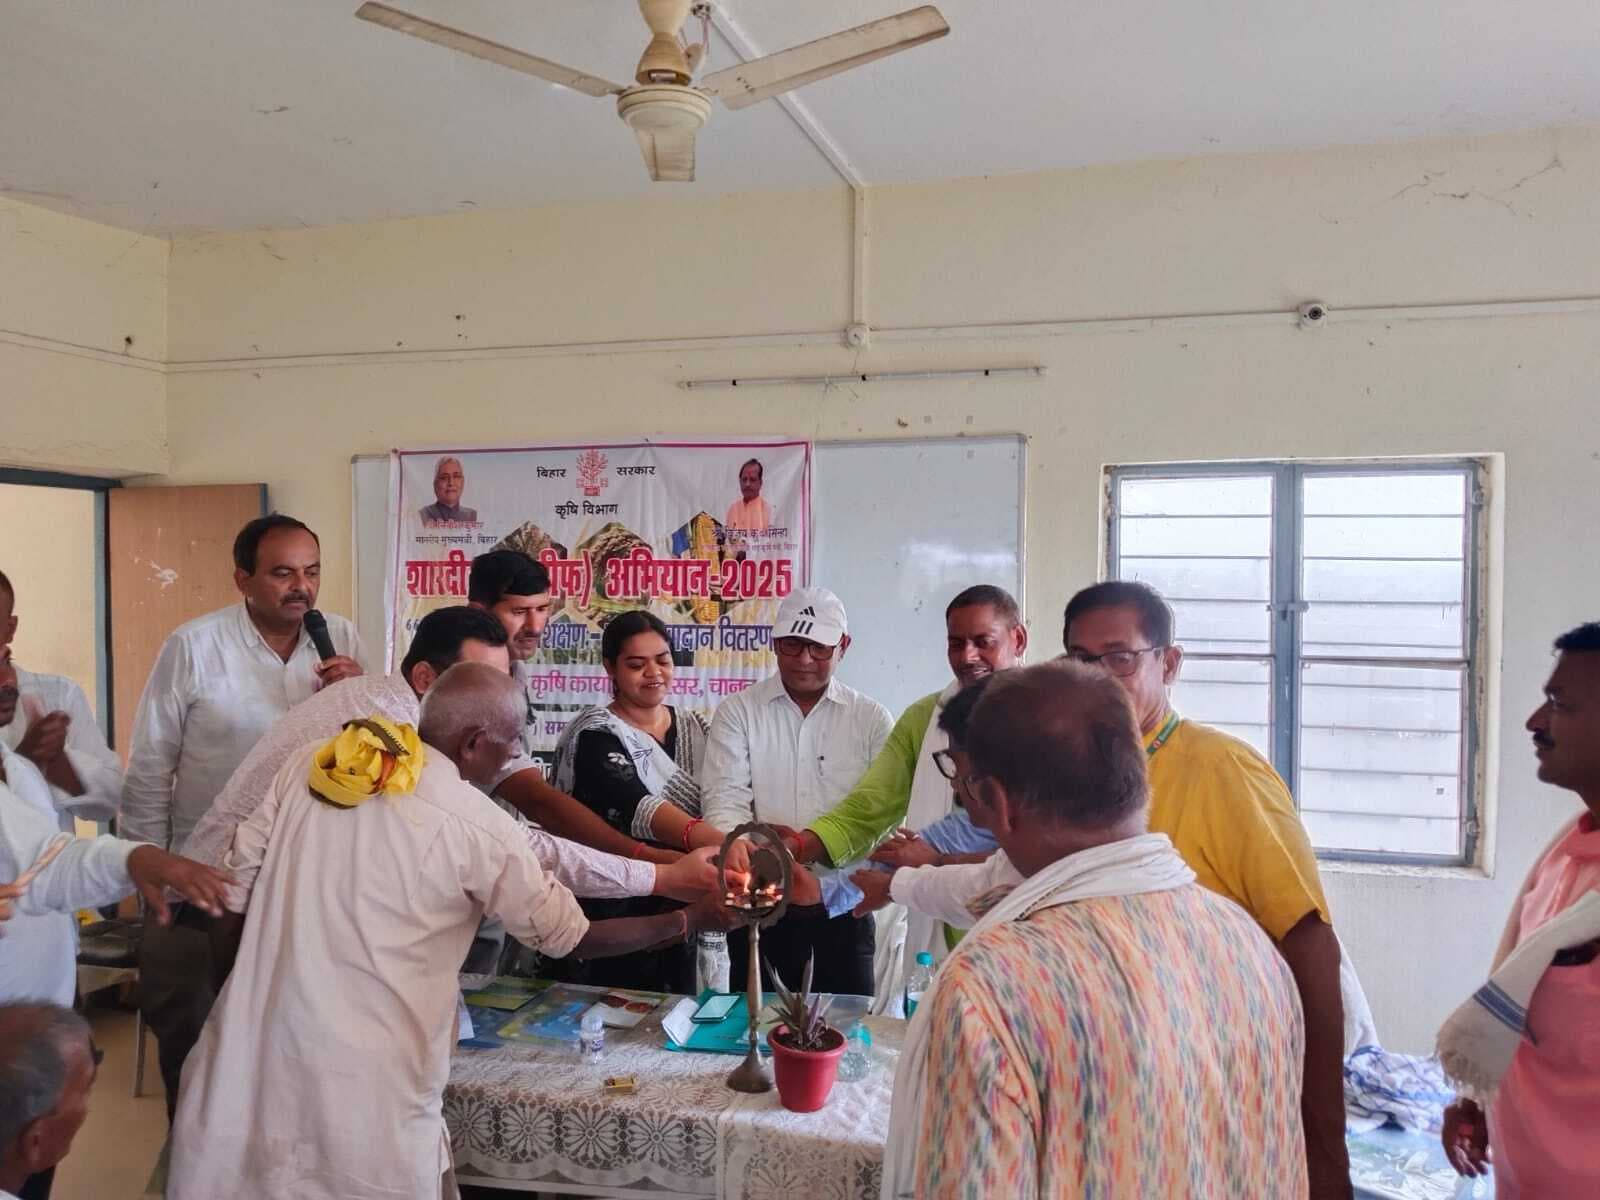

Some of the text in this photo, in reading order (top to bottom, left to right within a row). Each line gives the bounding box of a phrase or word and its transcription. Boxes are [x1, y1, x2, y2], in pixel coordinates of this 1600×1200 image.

[536, 465, 656, 479] बिहार सरकार
[555, 500, 618, 520] कृषि विभाग
[406, 550, 469, 597] शारदी
[531, 670, 566, 699] कृषि
